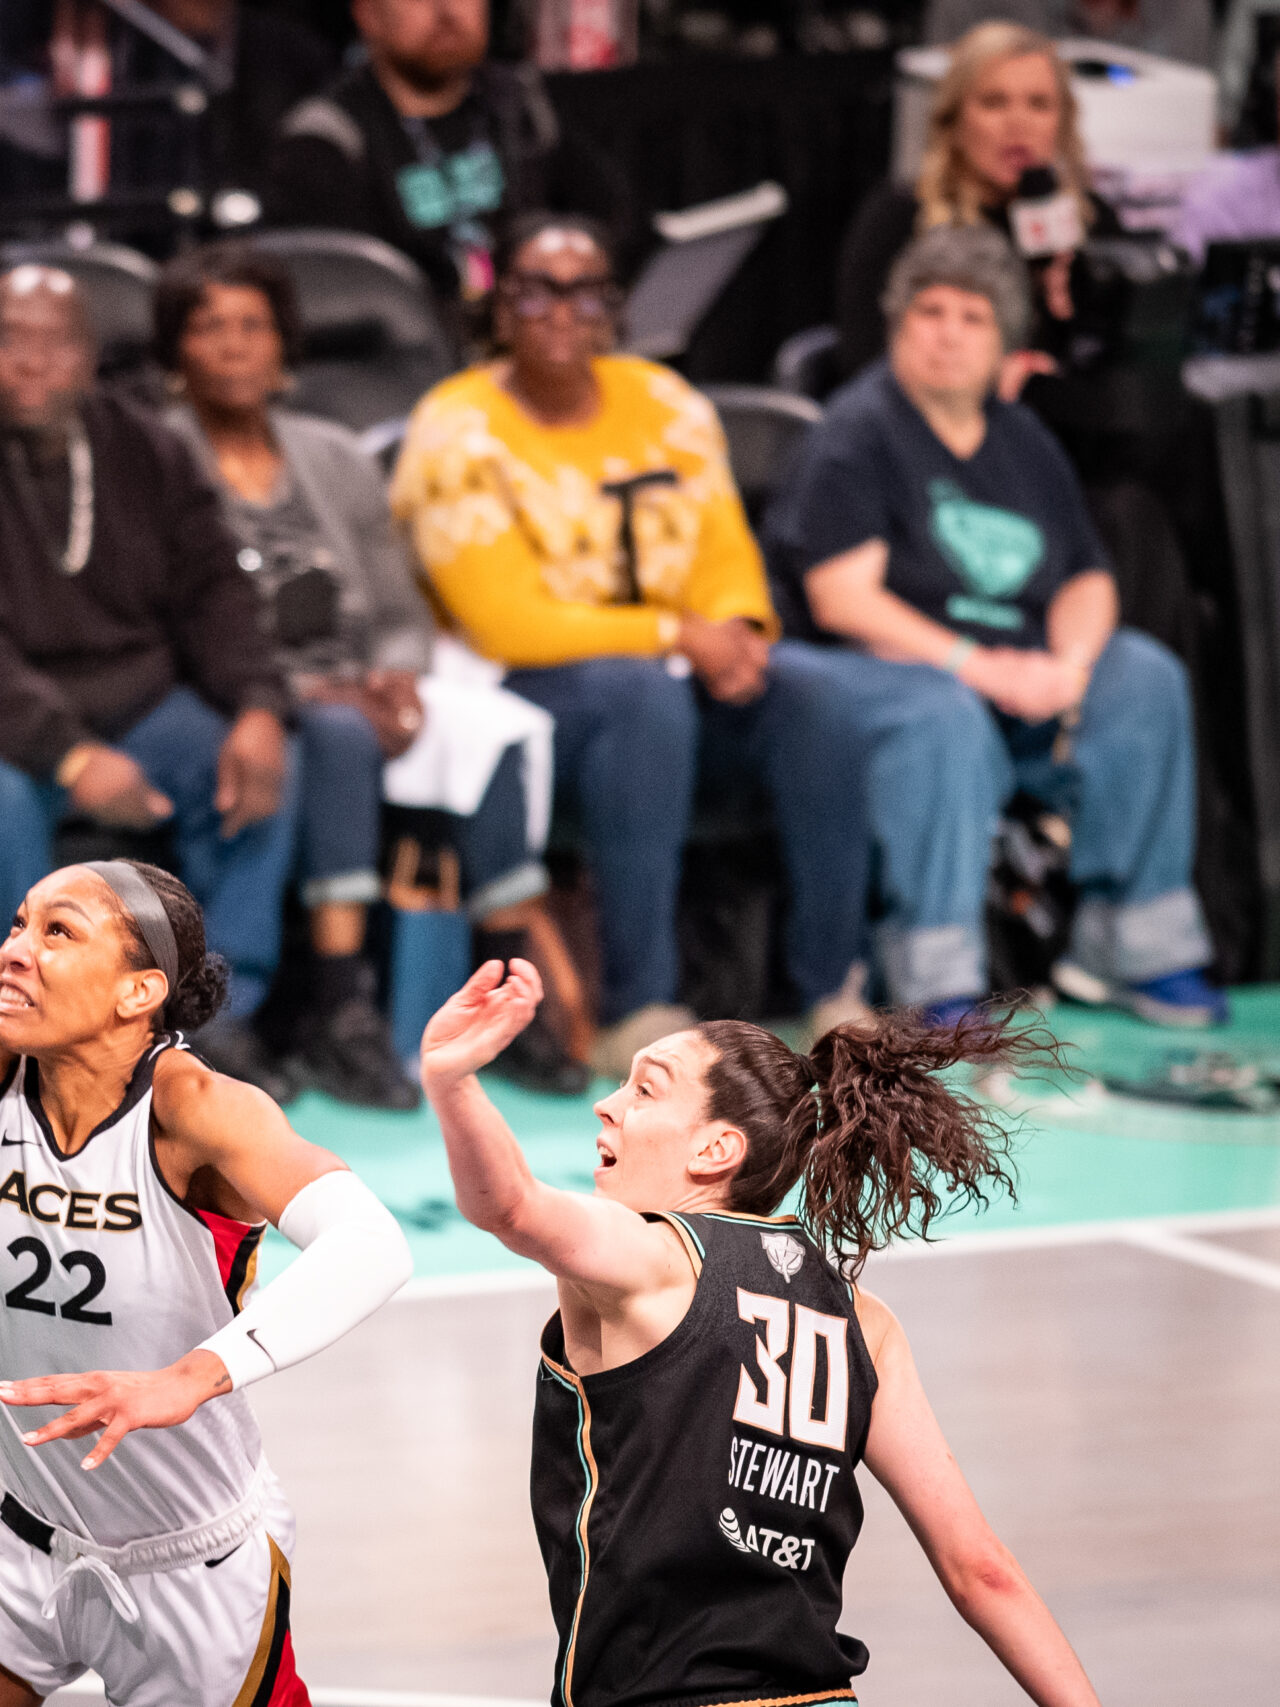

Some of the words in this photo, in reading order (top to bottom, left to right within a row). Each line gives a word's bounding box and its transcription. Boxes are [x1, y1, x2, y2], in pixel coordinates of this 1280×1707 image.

[4, 1236, 113, 1326] 22
[733, 1287, 848, 1451] 30
[728, 1436, 841, 1514] STEWART
[745, 1524, 816, 1571] AT&T
